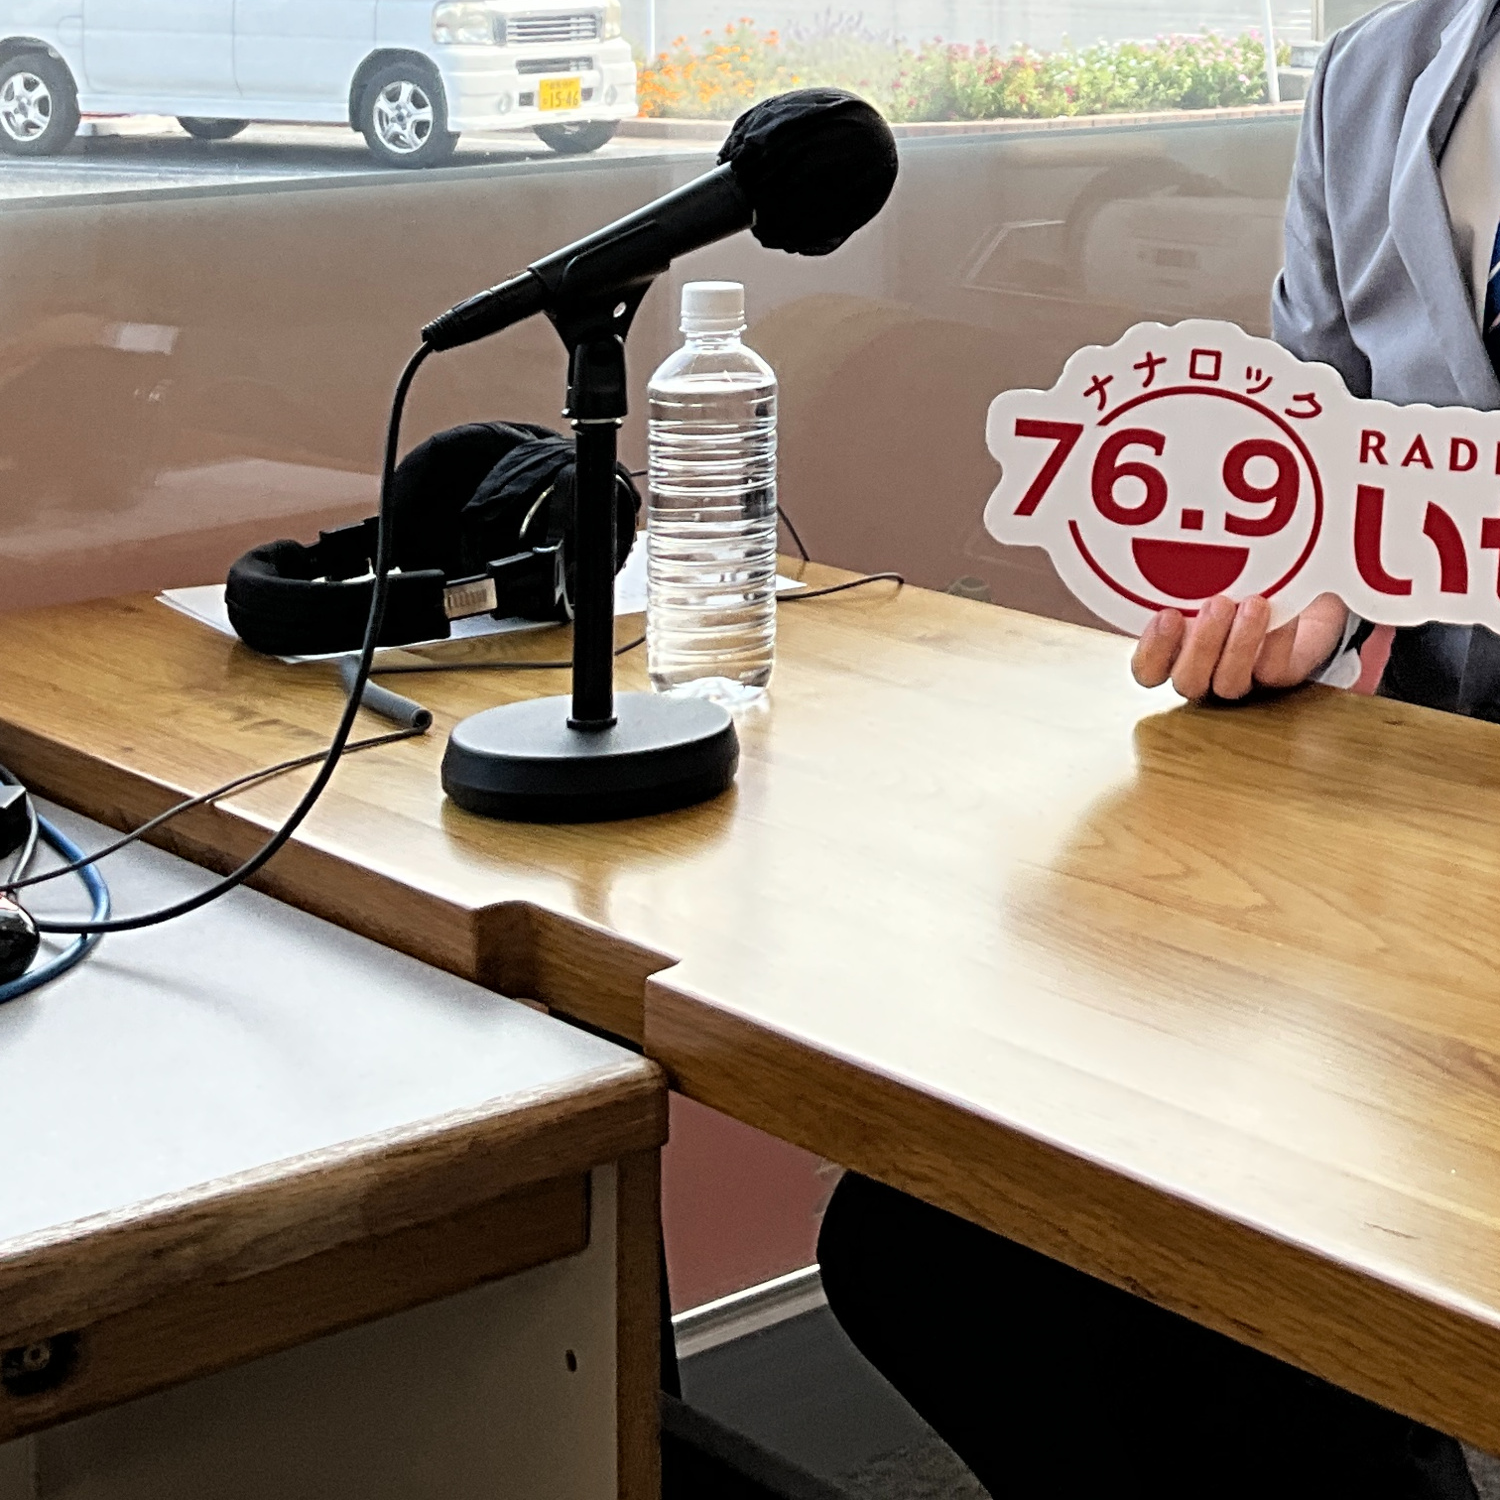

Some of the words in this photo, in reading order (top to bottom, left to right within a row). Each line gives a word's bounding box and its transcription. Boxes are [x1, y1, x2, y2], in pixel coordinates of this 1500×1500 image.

[1084, 347, 1324, 421] ナナロック
[1013, 417, 1302, 539] 76.9
